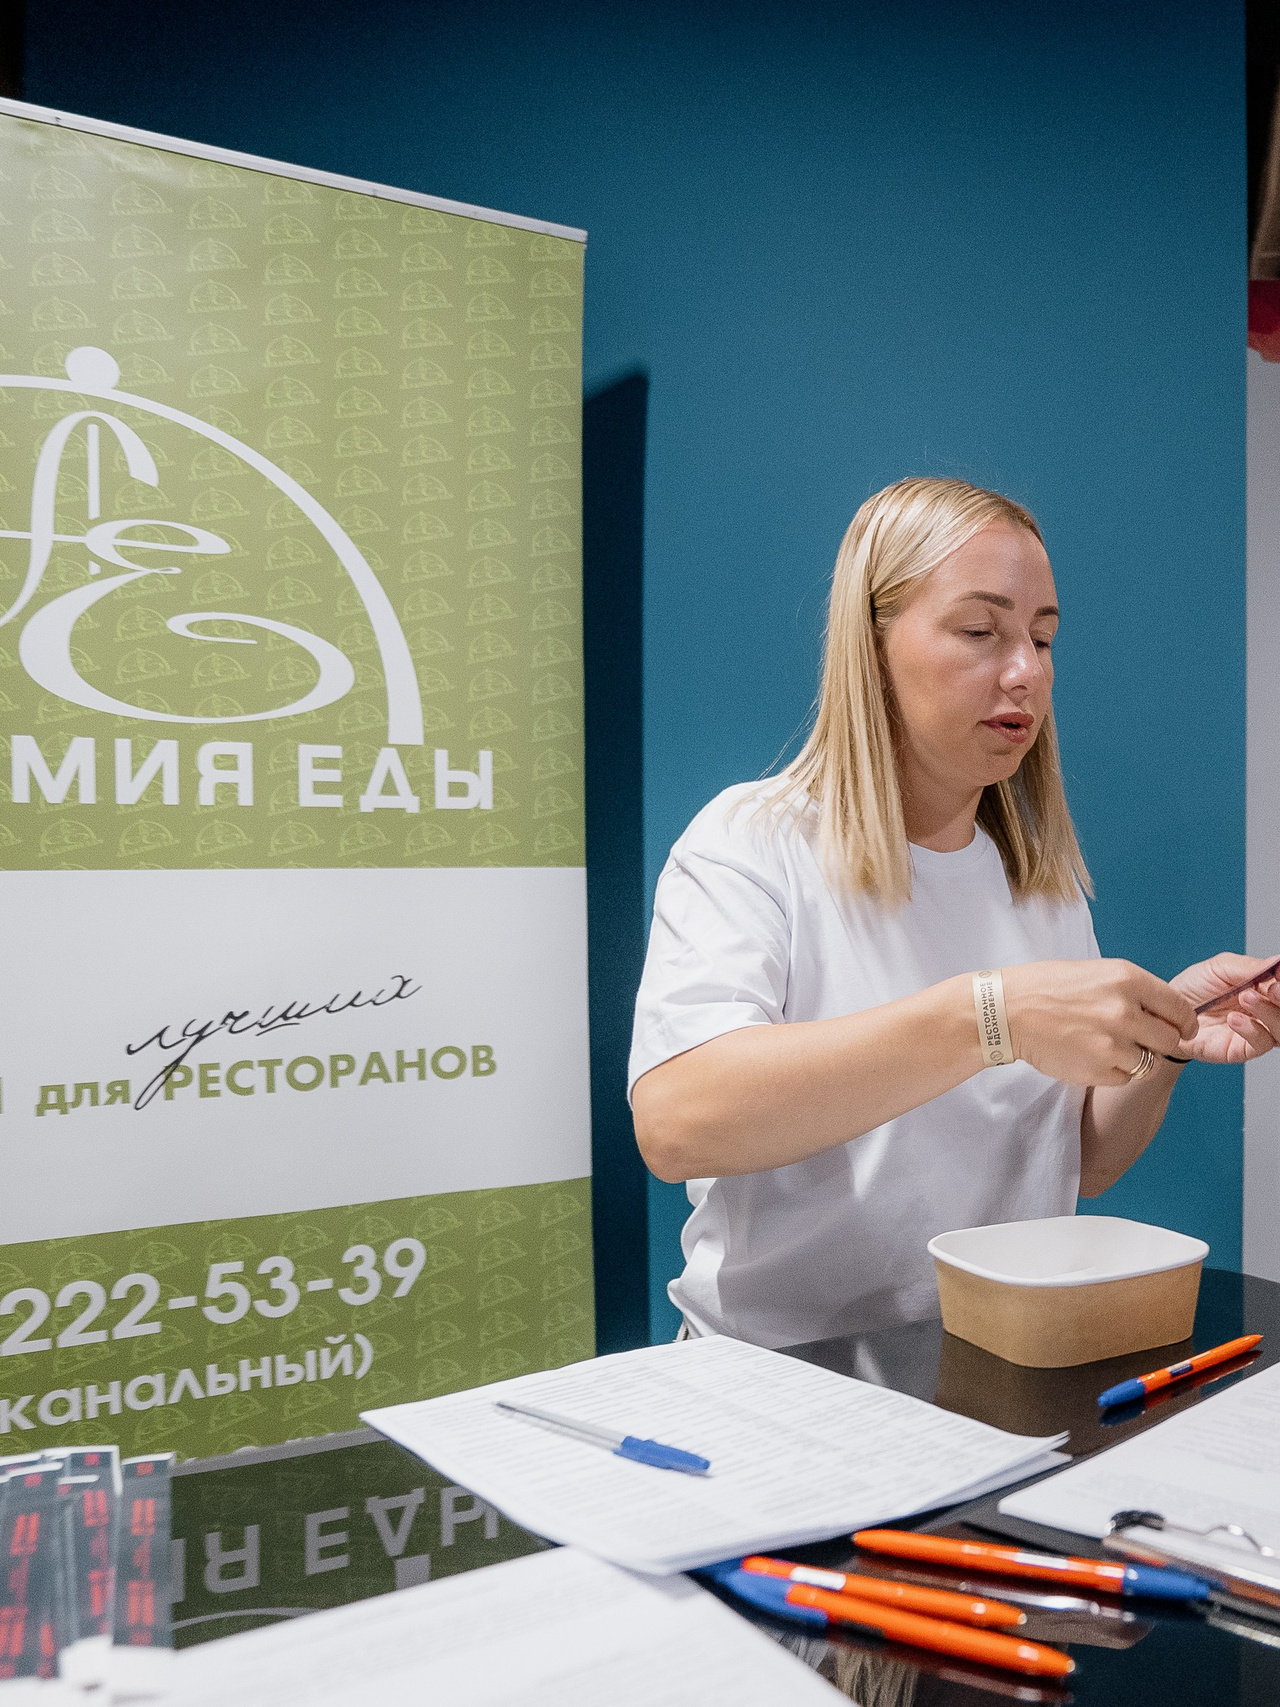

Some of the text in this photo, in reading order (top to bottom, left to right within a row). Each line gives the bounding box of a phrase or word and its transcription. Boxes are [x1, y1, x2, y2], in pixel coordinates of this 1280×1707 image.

[298, 744, 495, 814] ЕДЫ
[126, 975, 422, 1111] лучших
[980, 983, 994, 1046] РЕСТОРАННОЕ
[987, 981, 1002, 1046] ВДОХНОВЕНИЕ
[35, 1079, 131, 1117] для
[162, 1044, 497, 1101] РЕСТОРАНОВ
[0, 1237, 427, 1357] 222-53-39
